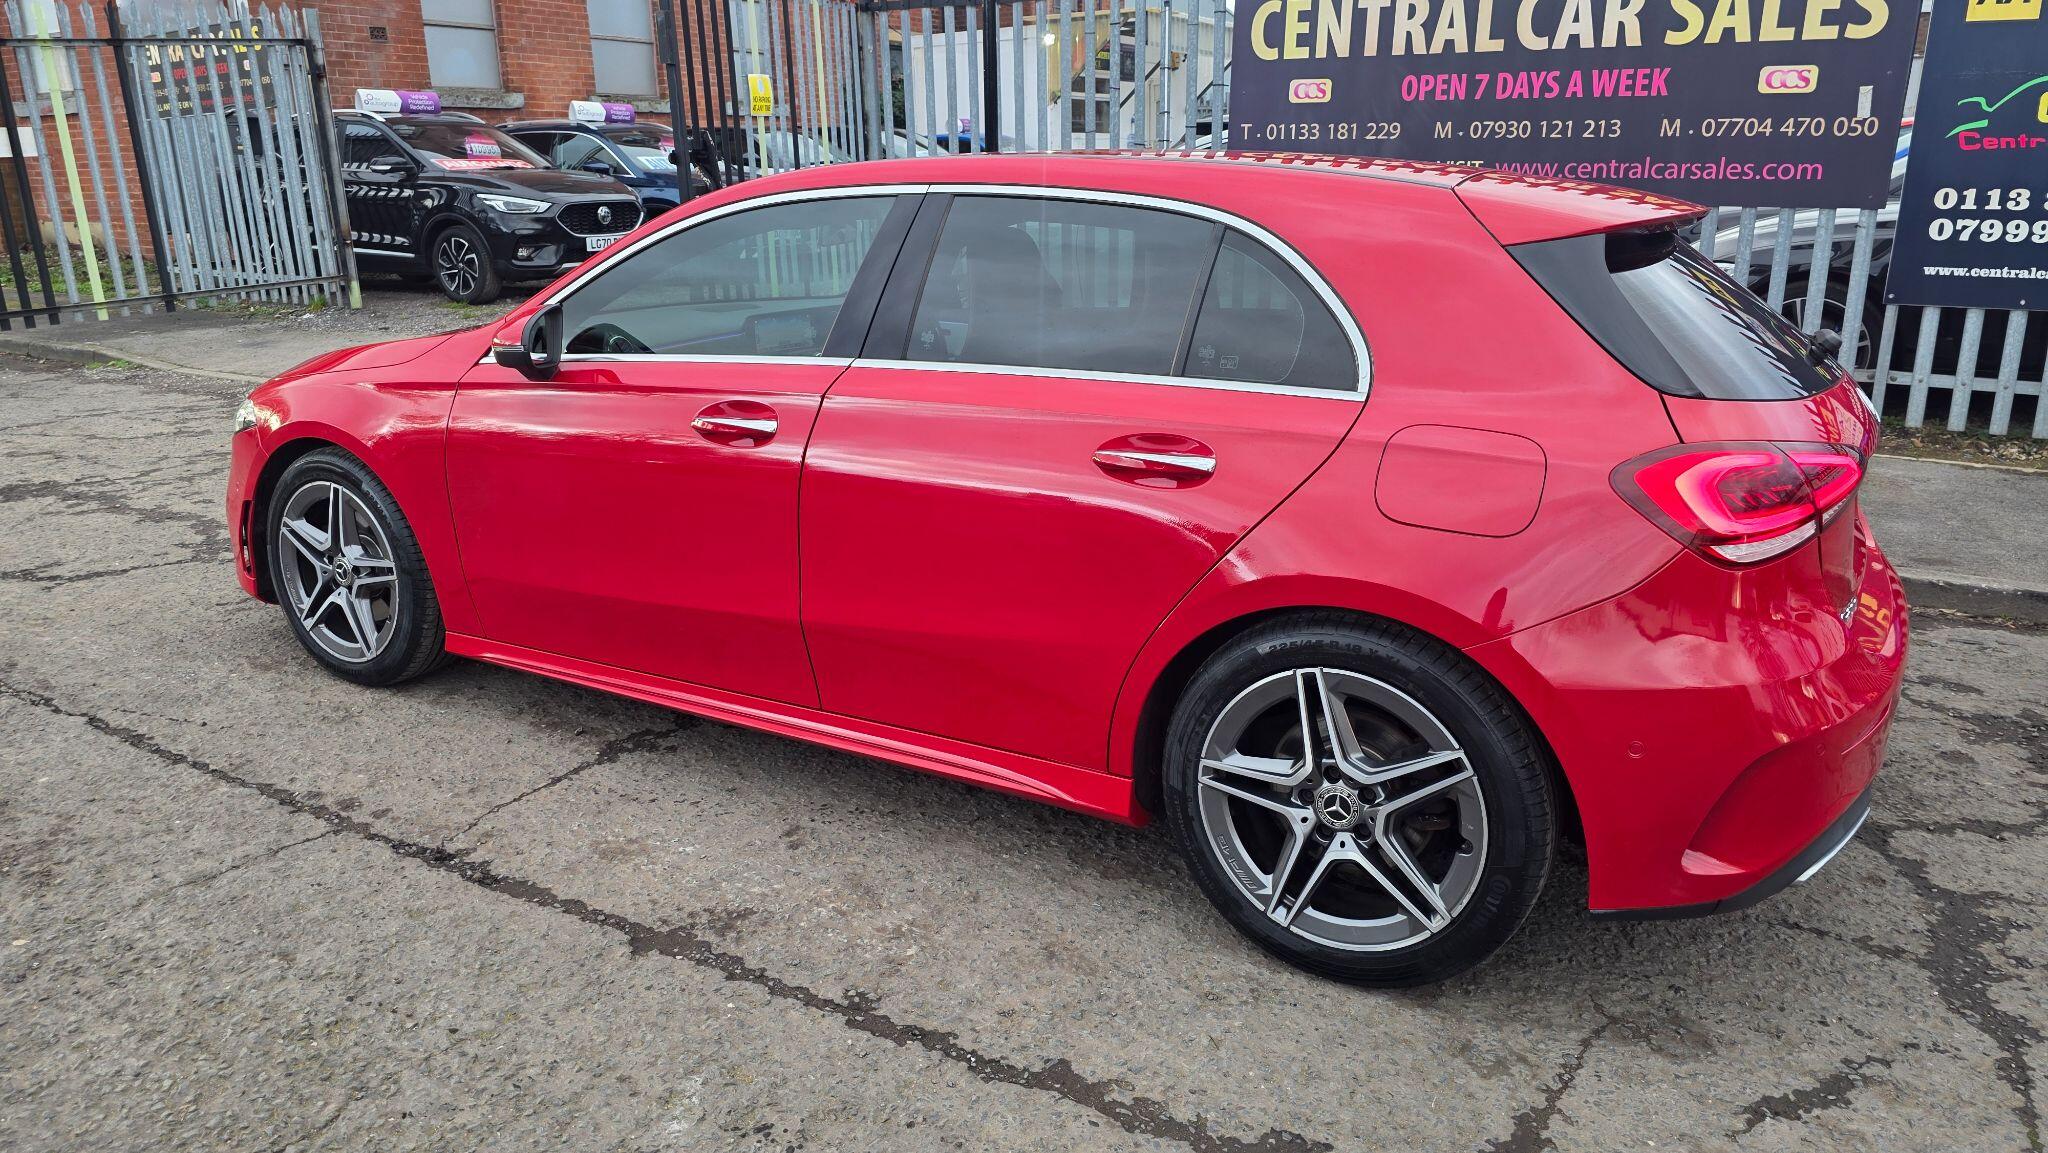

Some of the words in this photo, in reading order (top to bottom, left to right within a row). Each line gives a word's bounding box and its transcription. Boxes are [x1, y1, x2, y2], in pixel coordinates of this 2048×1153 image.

[1250, 0, 1504, 60] CENTRAL
[1516, 0, 1645, 50] CAR
[1663, 0, 1889, 45] SALES
[1401, 73, 1467, 102] OPEN
[1474, 73, 1491, 100] 7
[1495, 71, 1561, 100] DAYS
[1565, 70, 1583, 98] A
[1592, 67, 1672, 97] WEEK
[1765, 69, 1812, 90] CCS
[1293, 82, 1328, 100] CCS
[1241, 124, 1252, 138] T
[1266, 124, 1320, 140] 01133
[1328, 123, 1358, 140] 181
[1364, 122, 1401, 140] 229
[1434, 121, 1452, 138] M
[1469, 121, 1531, 138] 07930
[1540, 120, 1573, 138] 121
[1583, 119, 1621, 138] 213
[1660, 118, 1681, 137] M
[1701, 117, 1773, 138] 07704
[1780, 117, 1825, 137] 470
[1833, 116, 1879, 137] 050
[1495, 156, 1824, 181] www.centralcarsales.com
[1933, 187, 2031, 211] 0113
[1928, 218, 2048, 244] 07999
[1923, 266, 2048, 279] www.centralc
